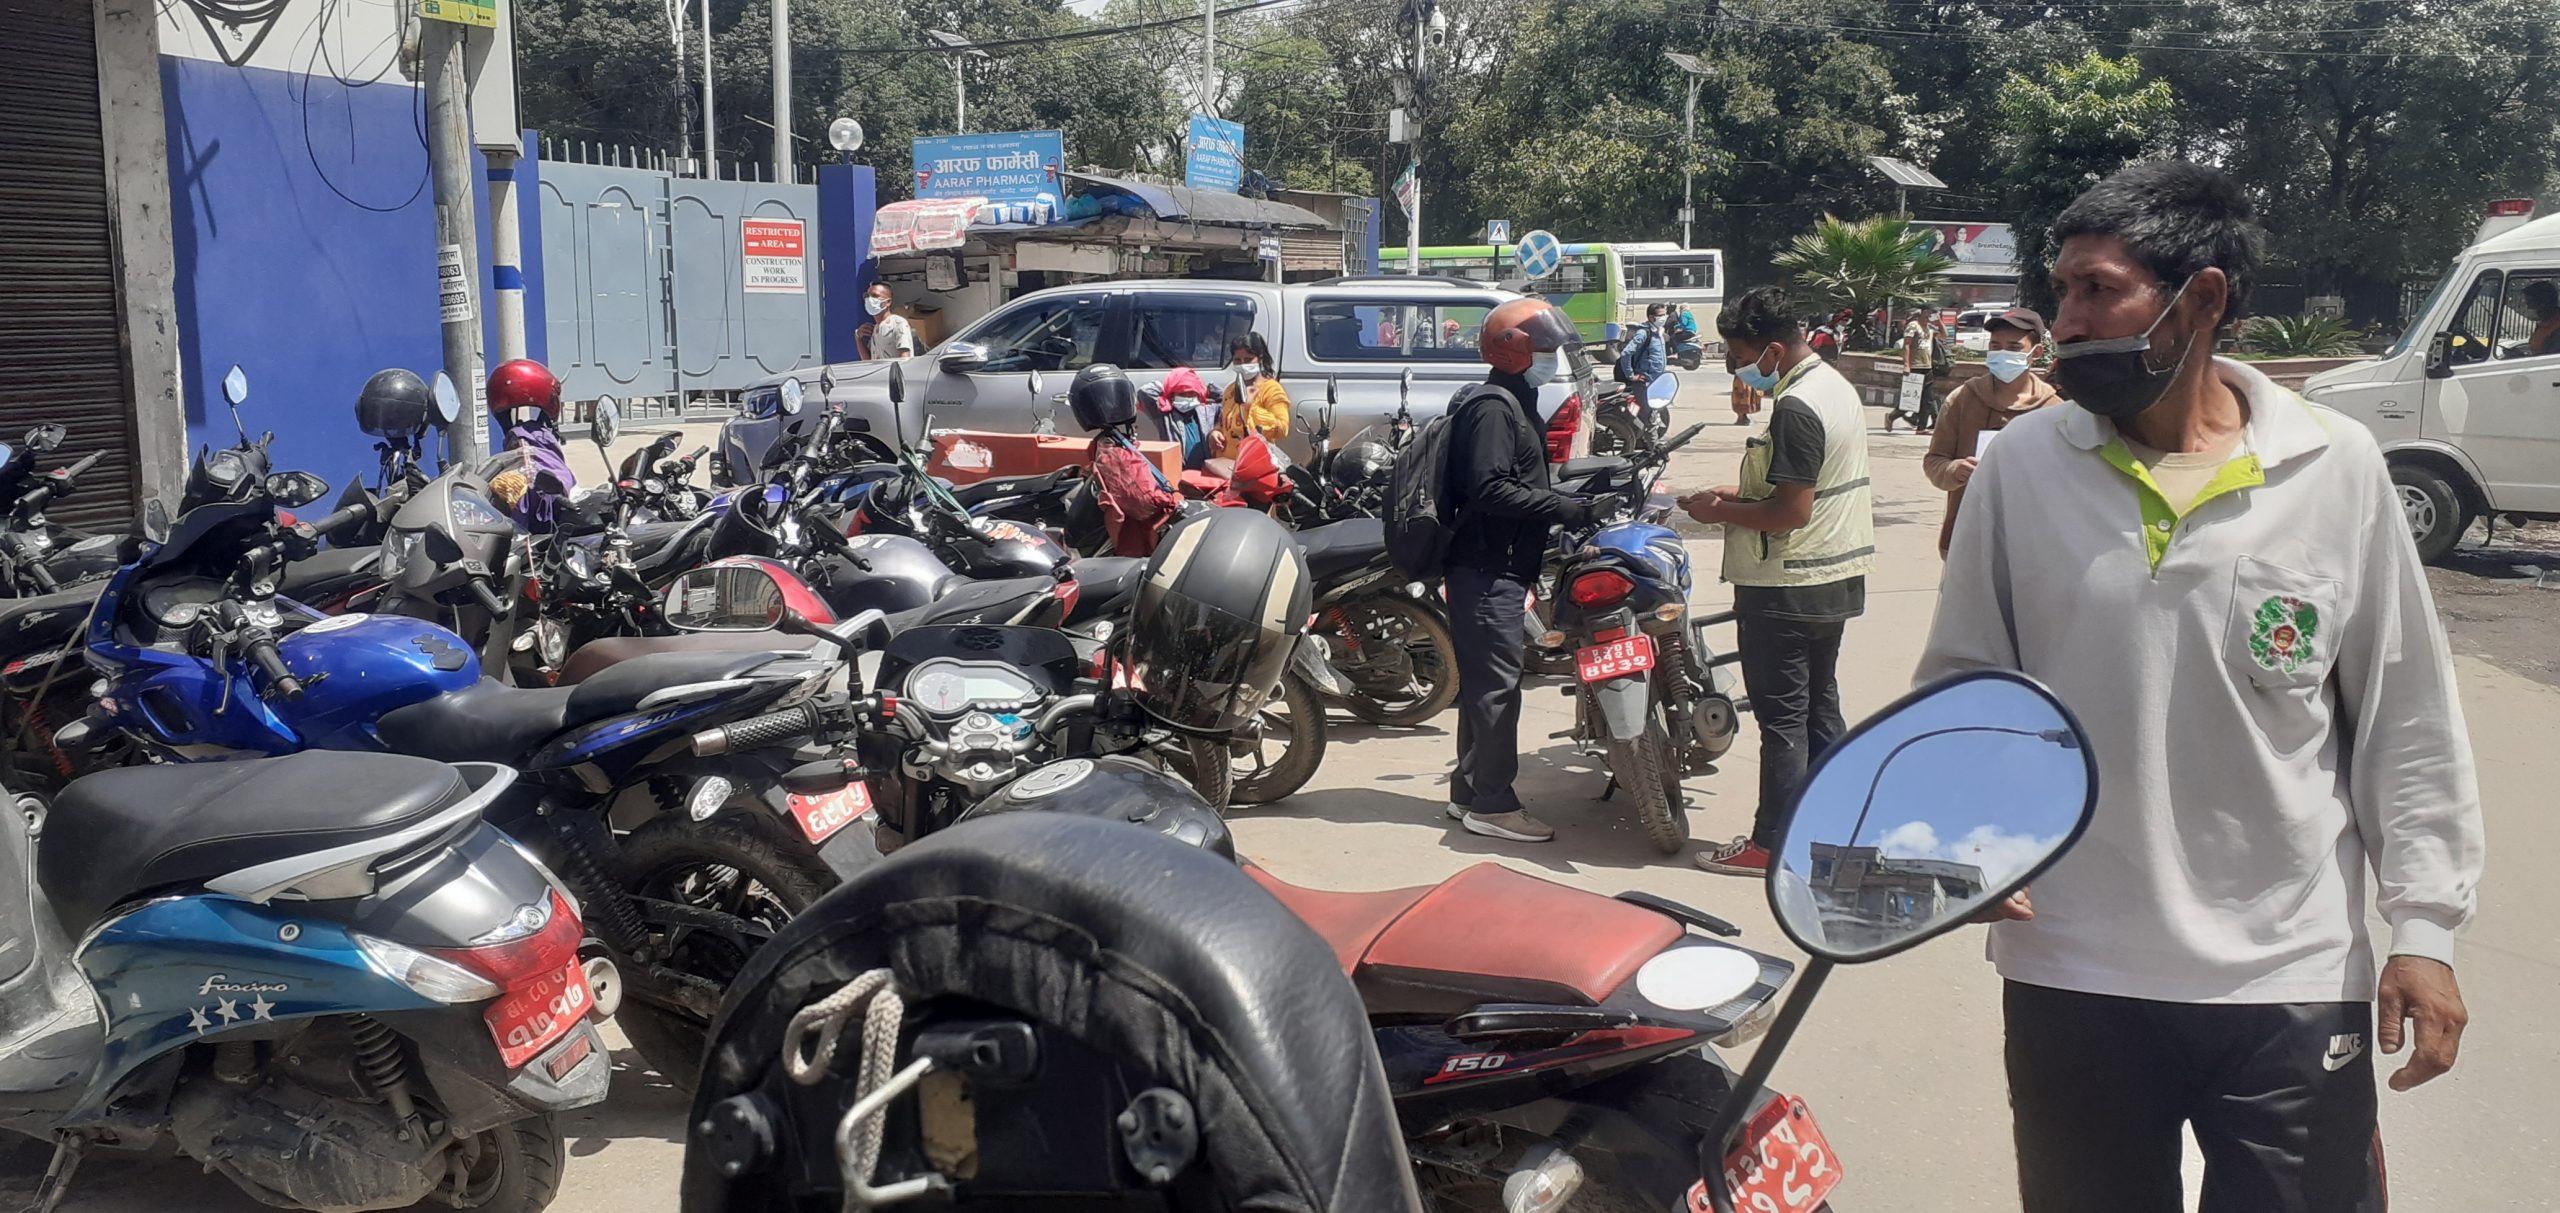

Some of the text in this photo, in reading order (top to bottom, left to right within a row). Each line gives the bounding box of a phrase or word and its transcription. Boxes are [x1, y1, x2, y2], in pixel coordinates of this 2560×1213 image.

[934, 150, 1040, 174] आरफ फार्मेसी
[934, 174, 1041, 188] AARAF PHARMACY
[746, 227, 800, 237] RESTRICTED
[760, 240, 784, 248] AREA
[746, 258, 802, 266] CONSTRUCTION
[761, 276, 798, 284] PROGRESS
[507, 983, 585, 1048] १७१७
[2329, 1033, 2361, 1055] NIKE
[1445, 1054, 1506, 1073] 150
